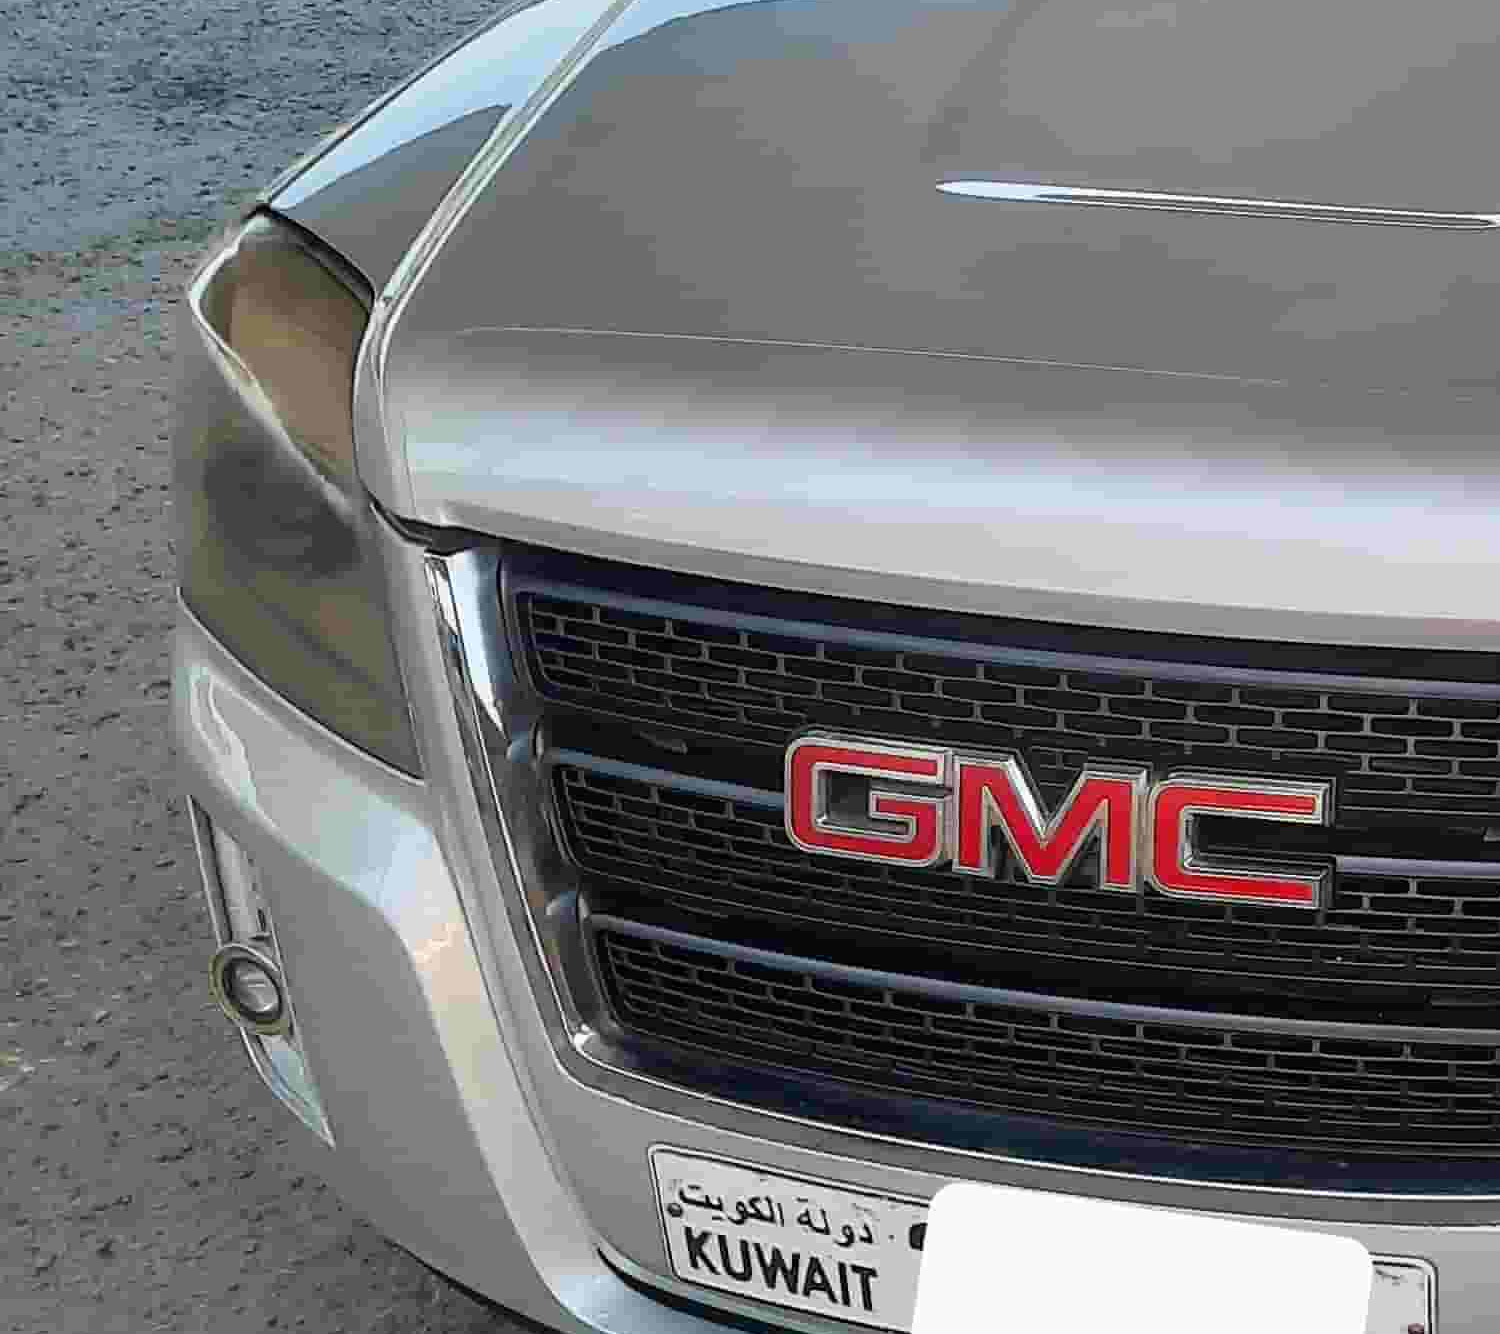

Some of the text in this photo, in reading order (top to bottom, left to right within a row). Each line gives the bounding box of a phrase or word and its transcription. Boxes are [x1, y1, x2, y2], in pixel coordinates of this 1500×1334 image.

[784, 733, 1334, 909] GMC
[678, 1183, 873, 1248] دولة الكويت
[684, 1226, 878, 1312] KUWAIT
